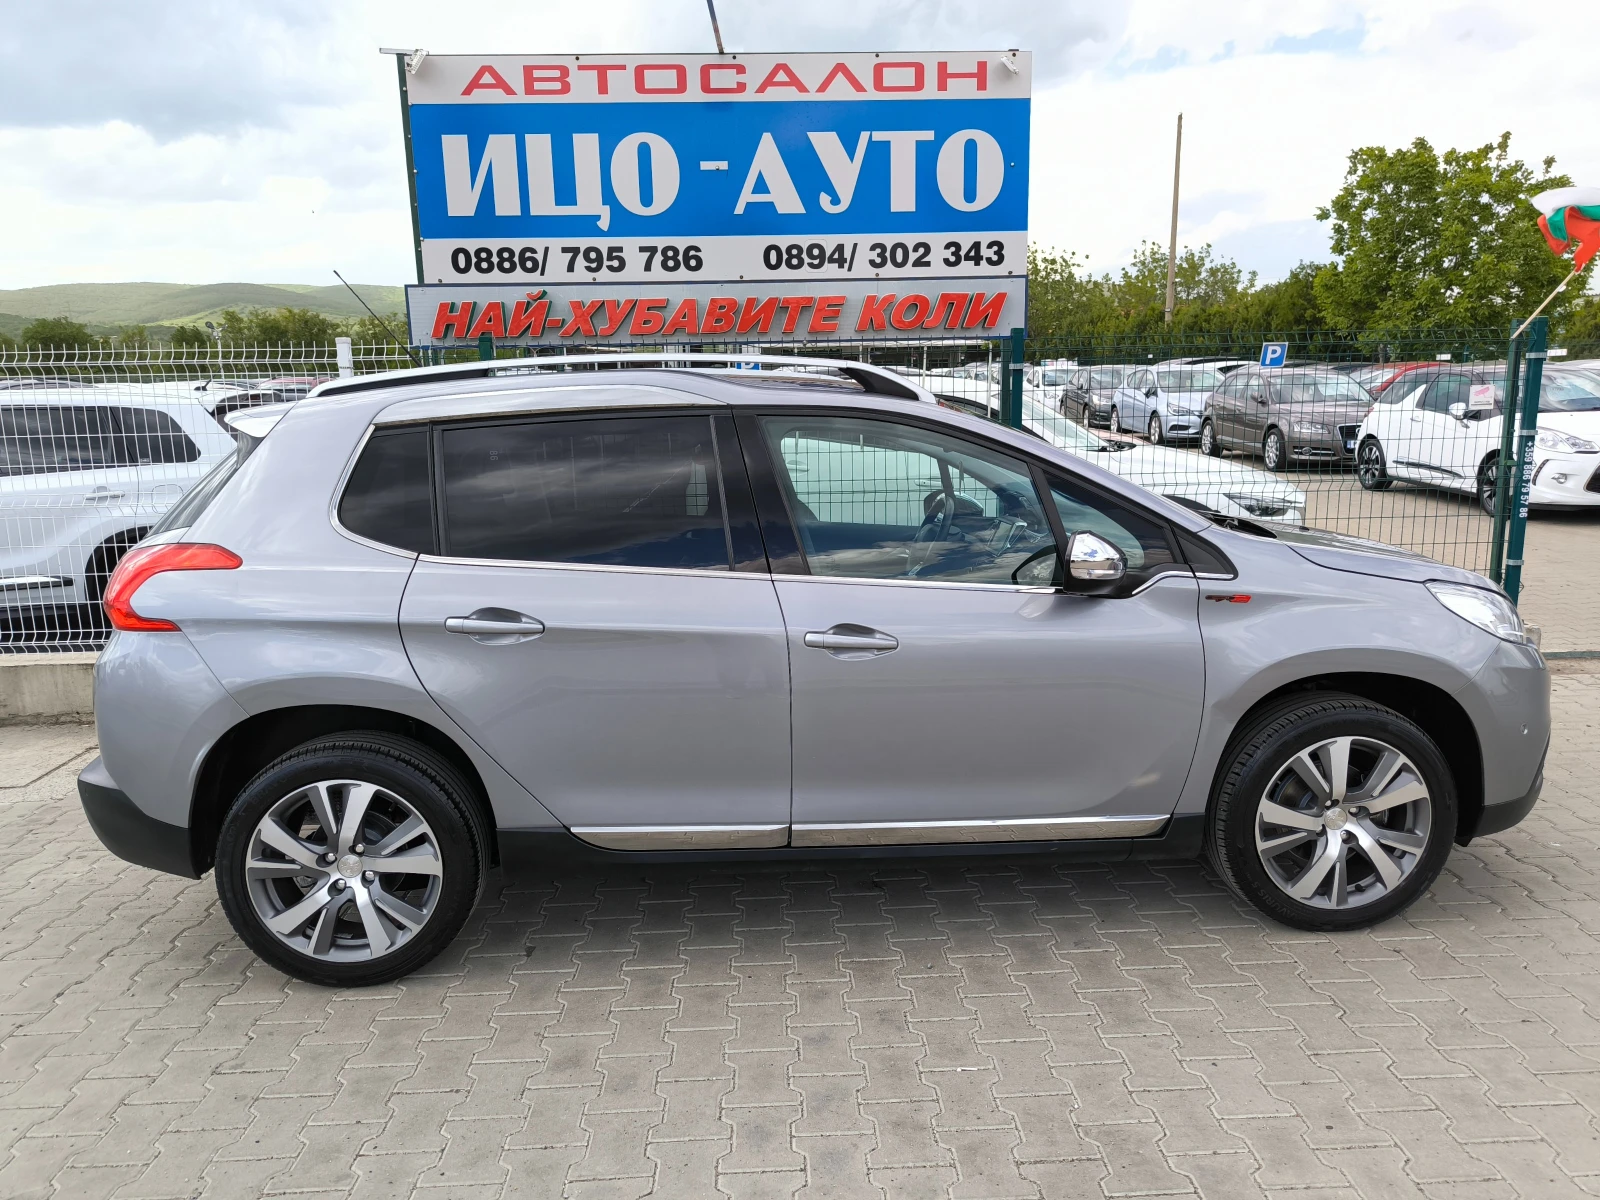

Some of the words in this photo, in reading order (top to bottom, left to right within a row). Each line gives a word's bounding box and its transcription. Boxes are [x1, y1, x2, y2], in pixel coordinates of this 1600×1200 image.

[460, 60, 988, 96] АВТОСАЛОН
[441, 131, 681, 231] ИЦО
[450, 246, 550, 276] 0886/
[560, 245, 627, 273] 795
[638, 244, 704, 273] 786
[762, 242, 859, 272] 0894/
[868, 241, 932, 269] 302
[942, 240, 1006, 267] 343
[430, 289, 847, 339] НАЙ-ХУБАВИТЕ
[855, 291, 1008, 332] КОЛИ
[1264, 345, 1283, 365] P
[1525, 441, 1534, 462] +359
[1523, 465, 1532, 480] 886
[1521, 482, 1531, 493] 79
[1520, 495, 1530, 505] 57
[1519, 507, 1528, 518] 86
